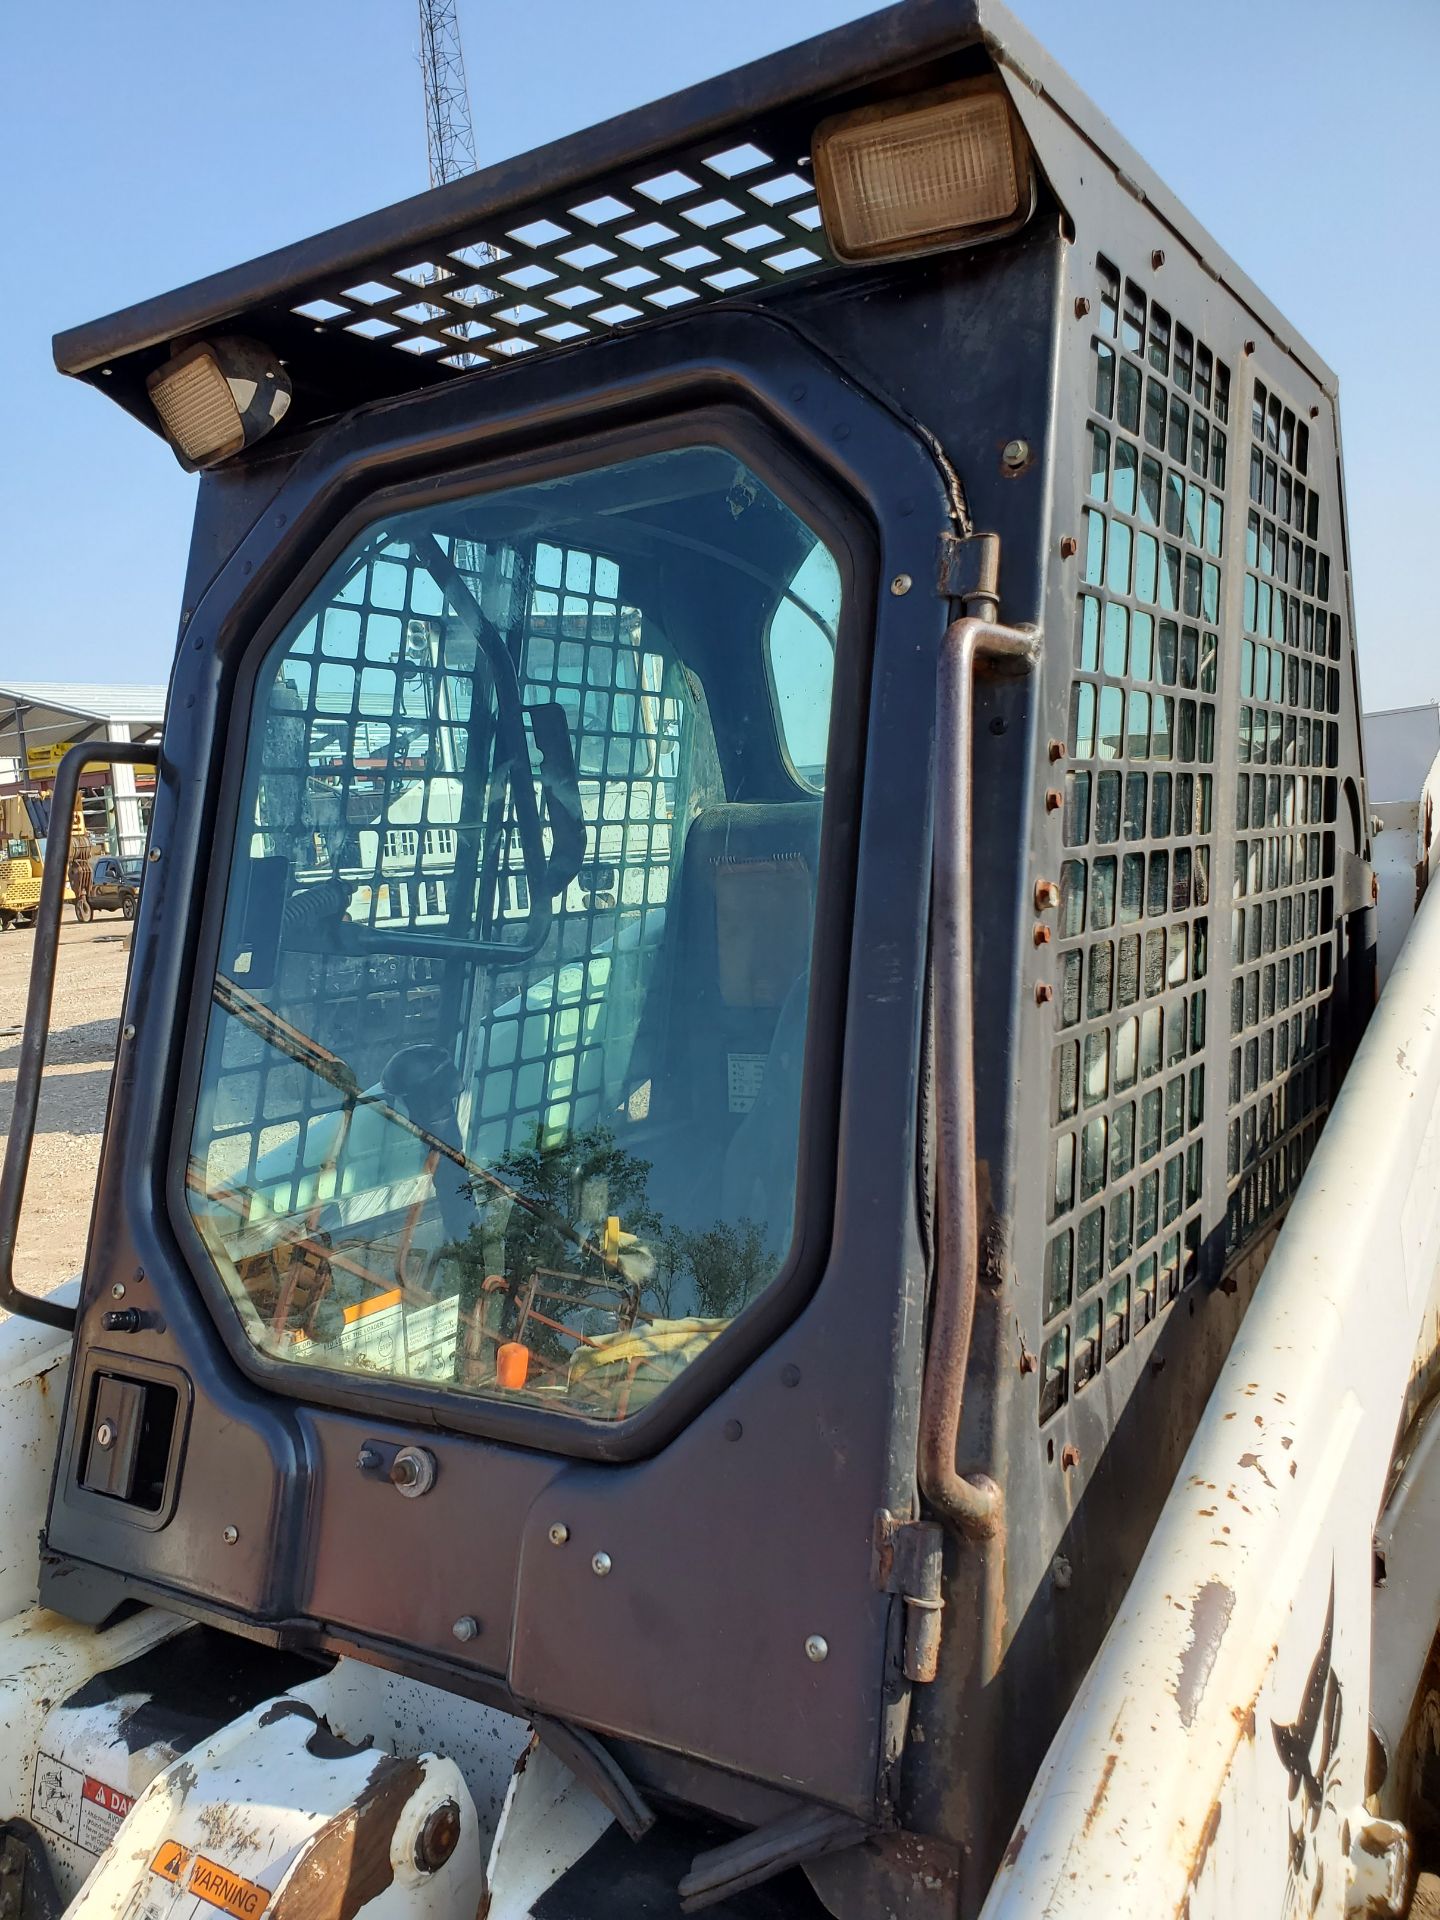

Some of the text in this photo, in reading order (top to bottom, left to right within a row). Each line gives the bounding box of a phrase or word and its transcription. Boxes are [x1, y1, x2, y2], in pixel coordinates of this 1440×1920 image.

[353, 1330, 363, 1338] THE
[379, 1341, 393, 1353] STOP
[193, 1865, 258, 1914] WARNING
